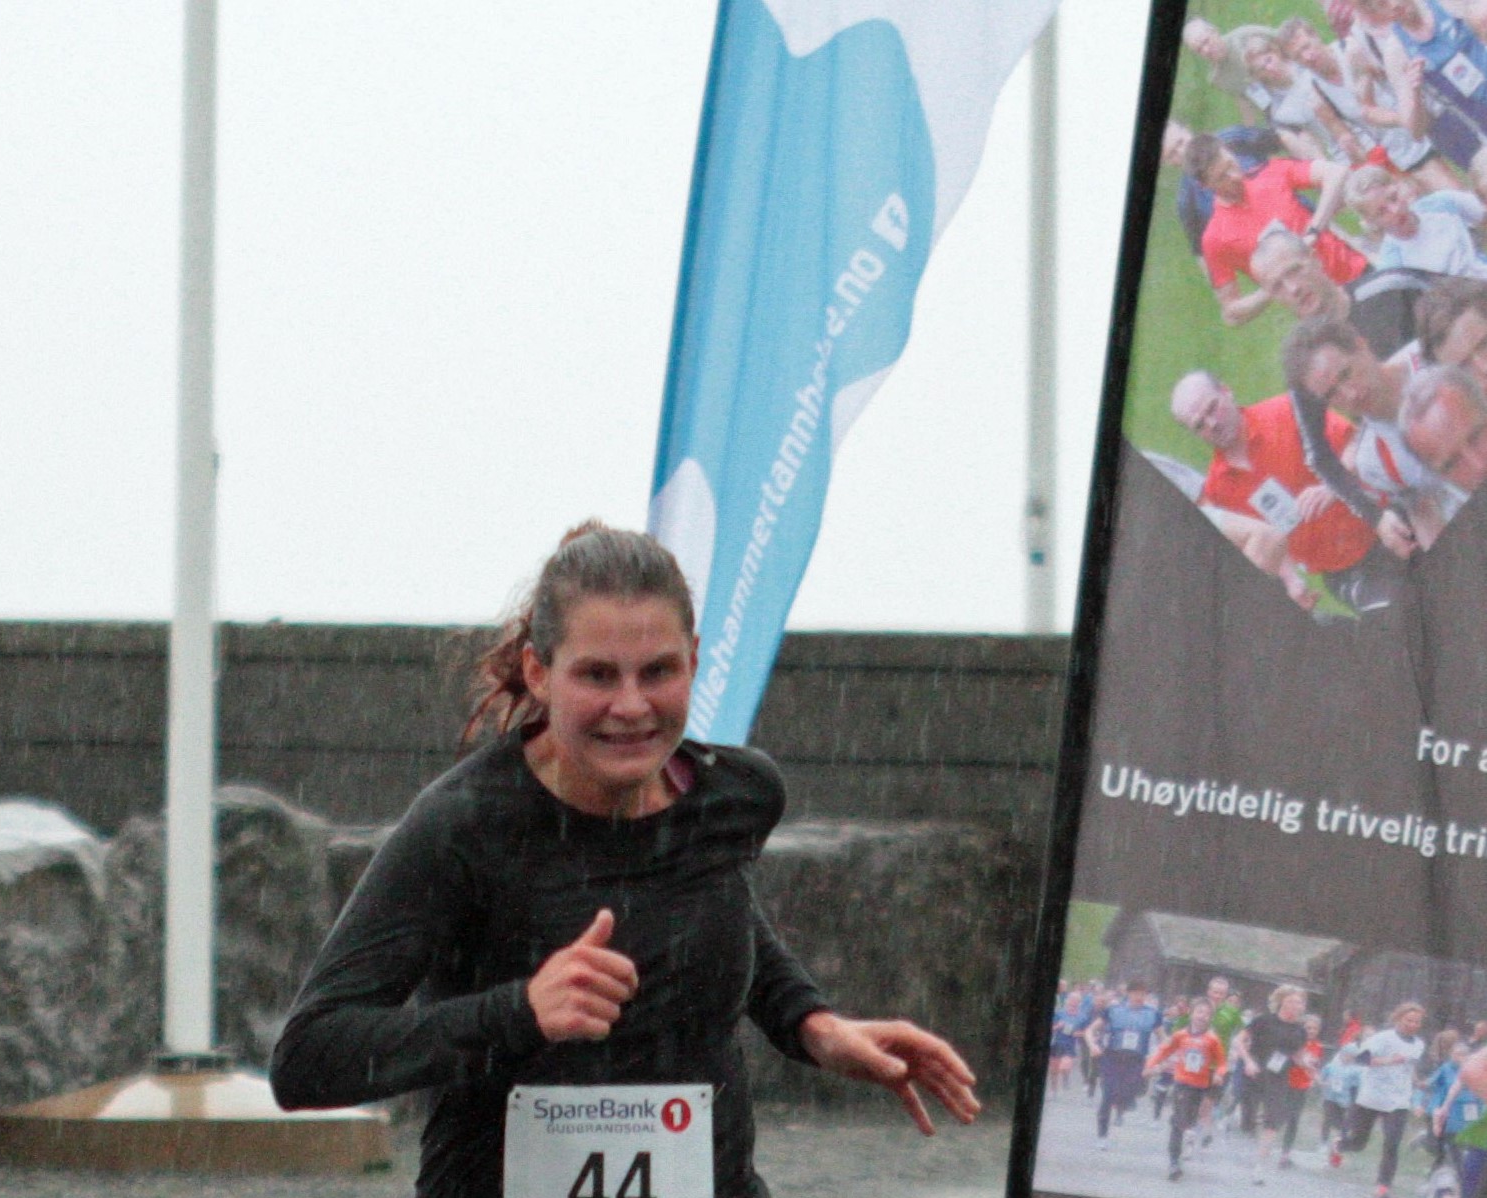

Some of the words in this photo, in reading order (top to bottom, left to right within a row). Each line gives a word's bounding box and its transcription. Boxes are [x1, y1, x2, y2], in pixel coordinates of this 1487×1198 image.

[1417, 728, 1470, 767] For
[1100, 763, 1304, 834] Uhøytidelig
[1316, 800, 1438, 858] trivelig
[534, 1098, 656, 1122] SpareBank
